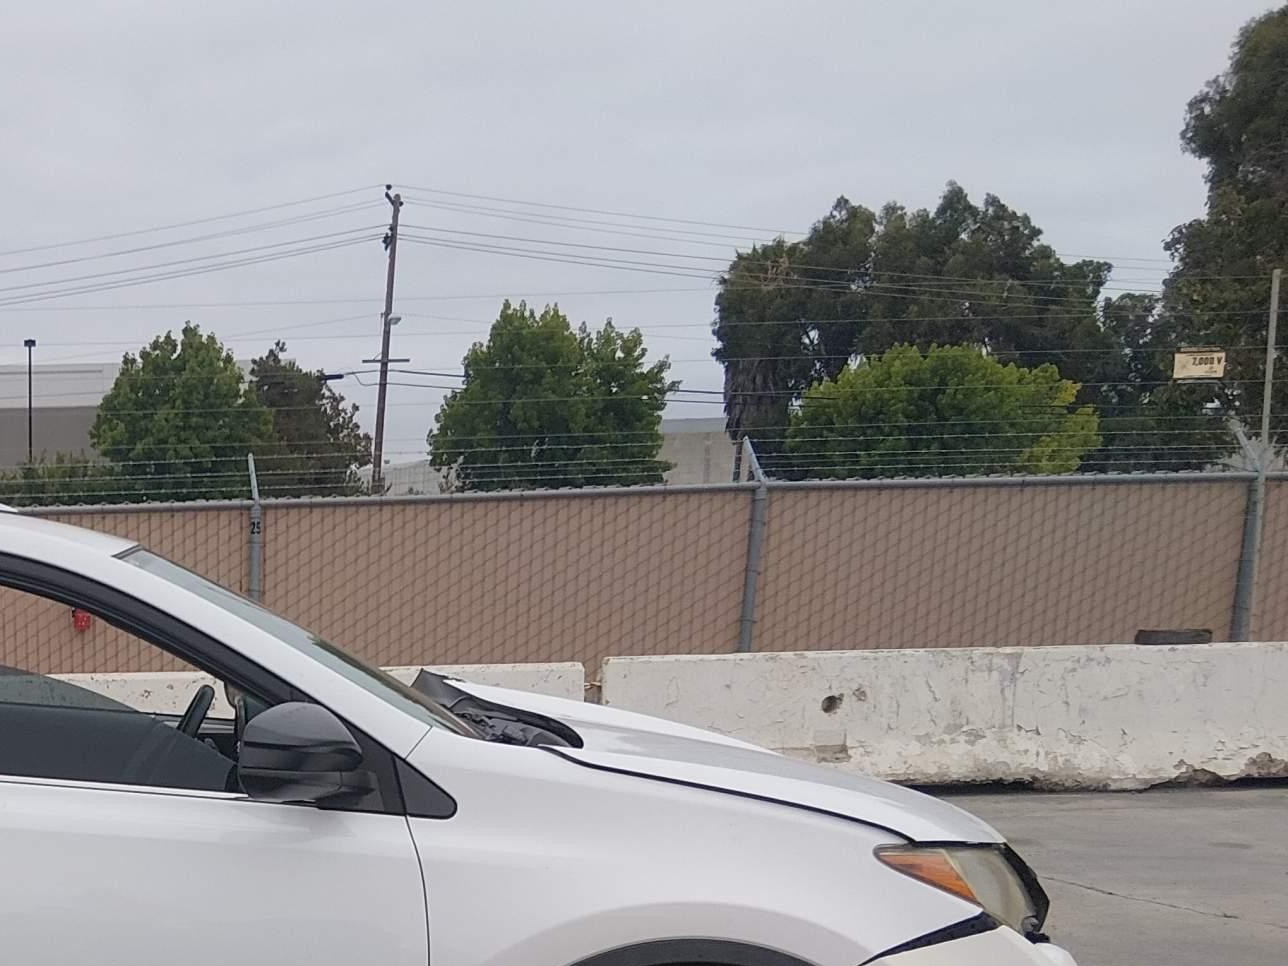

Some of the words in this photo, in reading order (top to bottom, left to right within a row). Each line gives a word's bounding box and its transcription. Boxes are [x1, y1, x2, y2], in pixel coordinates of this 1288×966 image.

[1192, 356, 1214, 366] 7,000
[1217, 356, 1223, 365] V
[250, 521, 261, 535] 25
